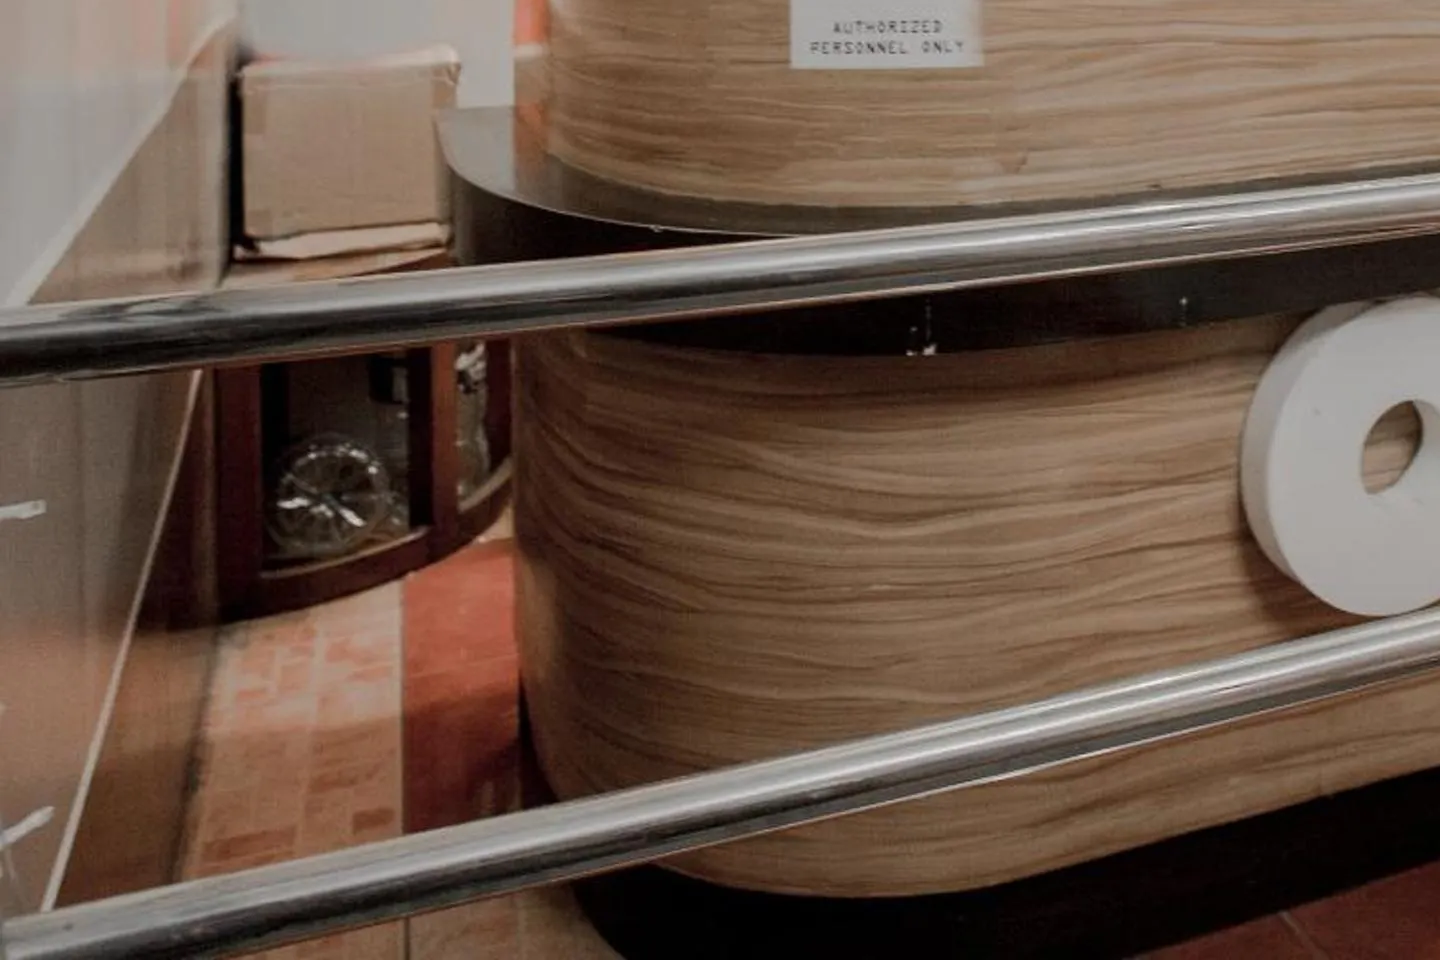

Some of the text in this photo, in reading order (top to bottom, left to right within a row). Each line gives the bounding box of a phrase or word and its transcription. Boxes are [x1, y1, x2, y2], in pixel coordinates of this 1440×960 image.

[833, 19, 944, 34] AUTHORIZED
[809, 41, 964, 55] PERSONNEL ONLY
